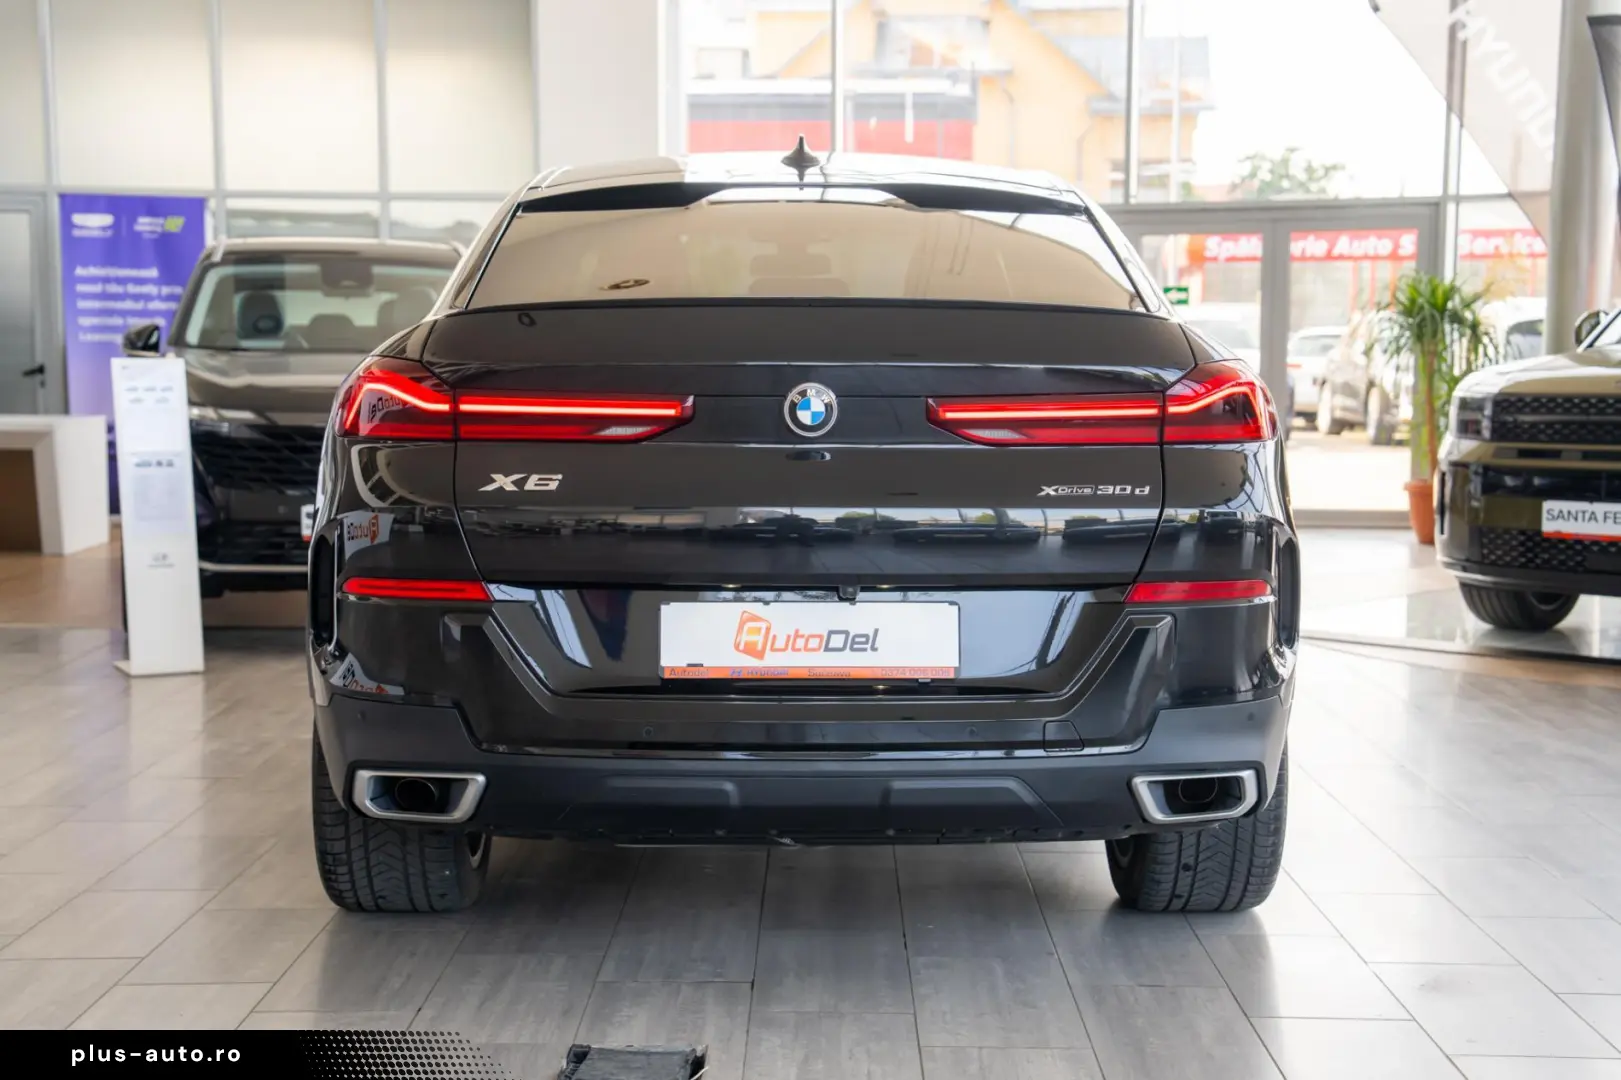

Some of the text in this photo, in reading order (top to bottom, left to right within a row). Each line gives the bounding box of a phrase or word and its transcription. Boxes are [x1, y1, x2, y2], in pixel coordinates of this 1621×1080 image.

[1331, 233, 1393, 257] Auto
[791, 388, 832, 404] BMW
[477, 473, 563, 491] X6
[1545, 508, 1621, 525] SANTA FE
[736, 617, 879, 655] AutoDel
